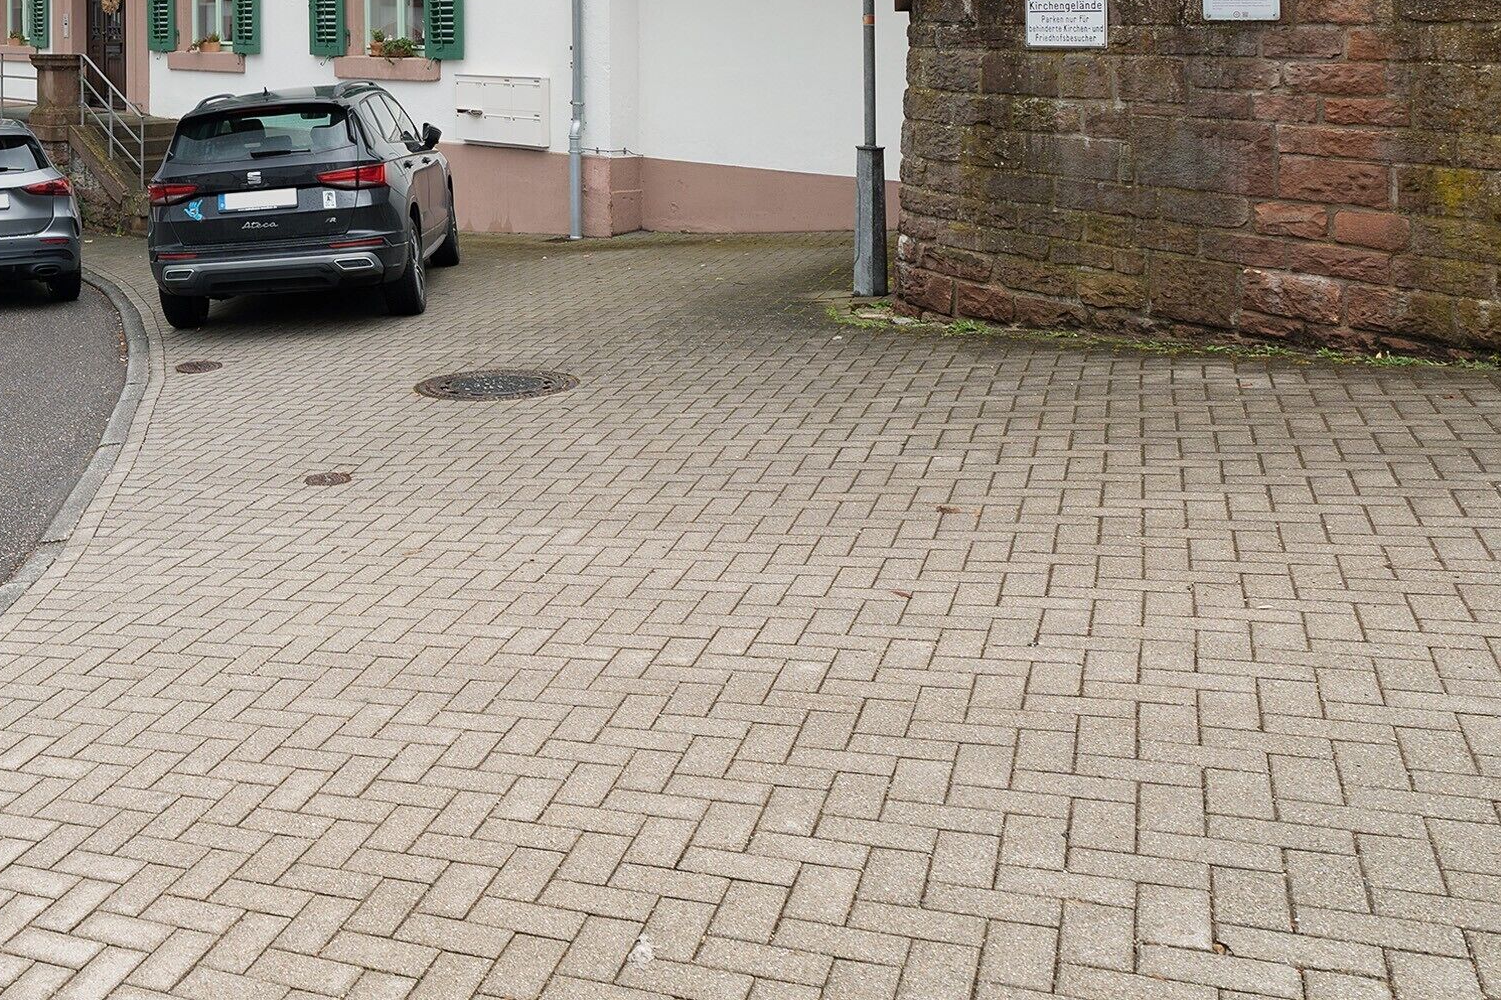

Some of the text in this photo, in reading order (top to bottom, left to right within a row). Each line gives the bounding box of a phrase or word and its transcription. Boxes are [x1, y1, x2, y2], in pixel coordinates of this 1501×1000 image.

[1029, 0, 1103, 12] Kirchengelände
[1041, 14, 1063, 23] Parken
[1029, 25, 1062, 33] behinderte
[1092, 25, 1103, 33] und
[1035, 33, 1097, 42] Friedhofsbesucher
[241, 221, 279, 230] Ateca
